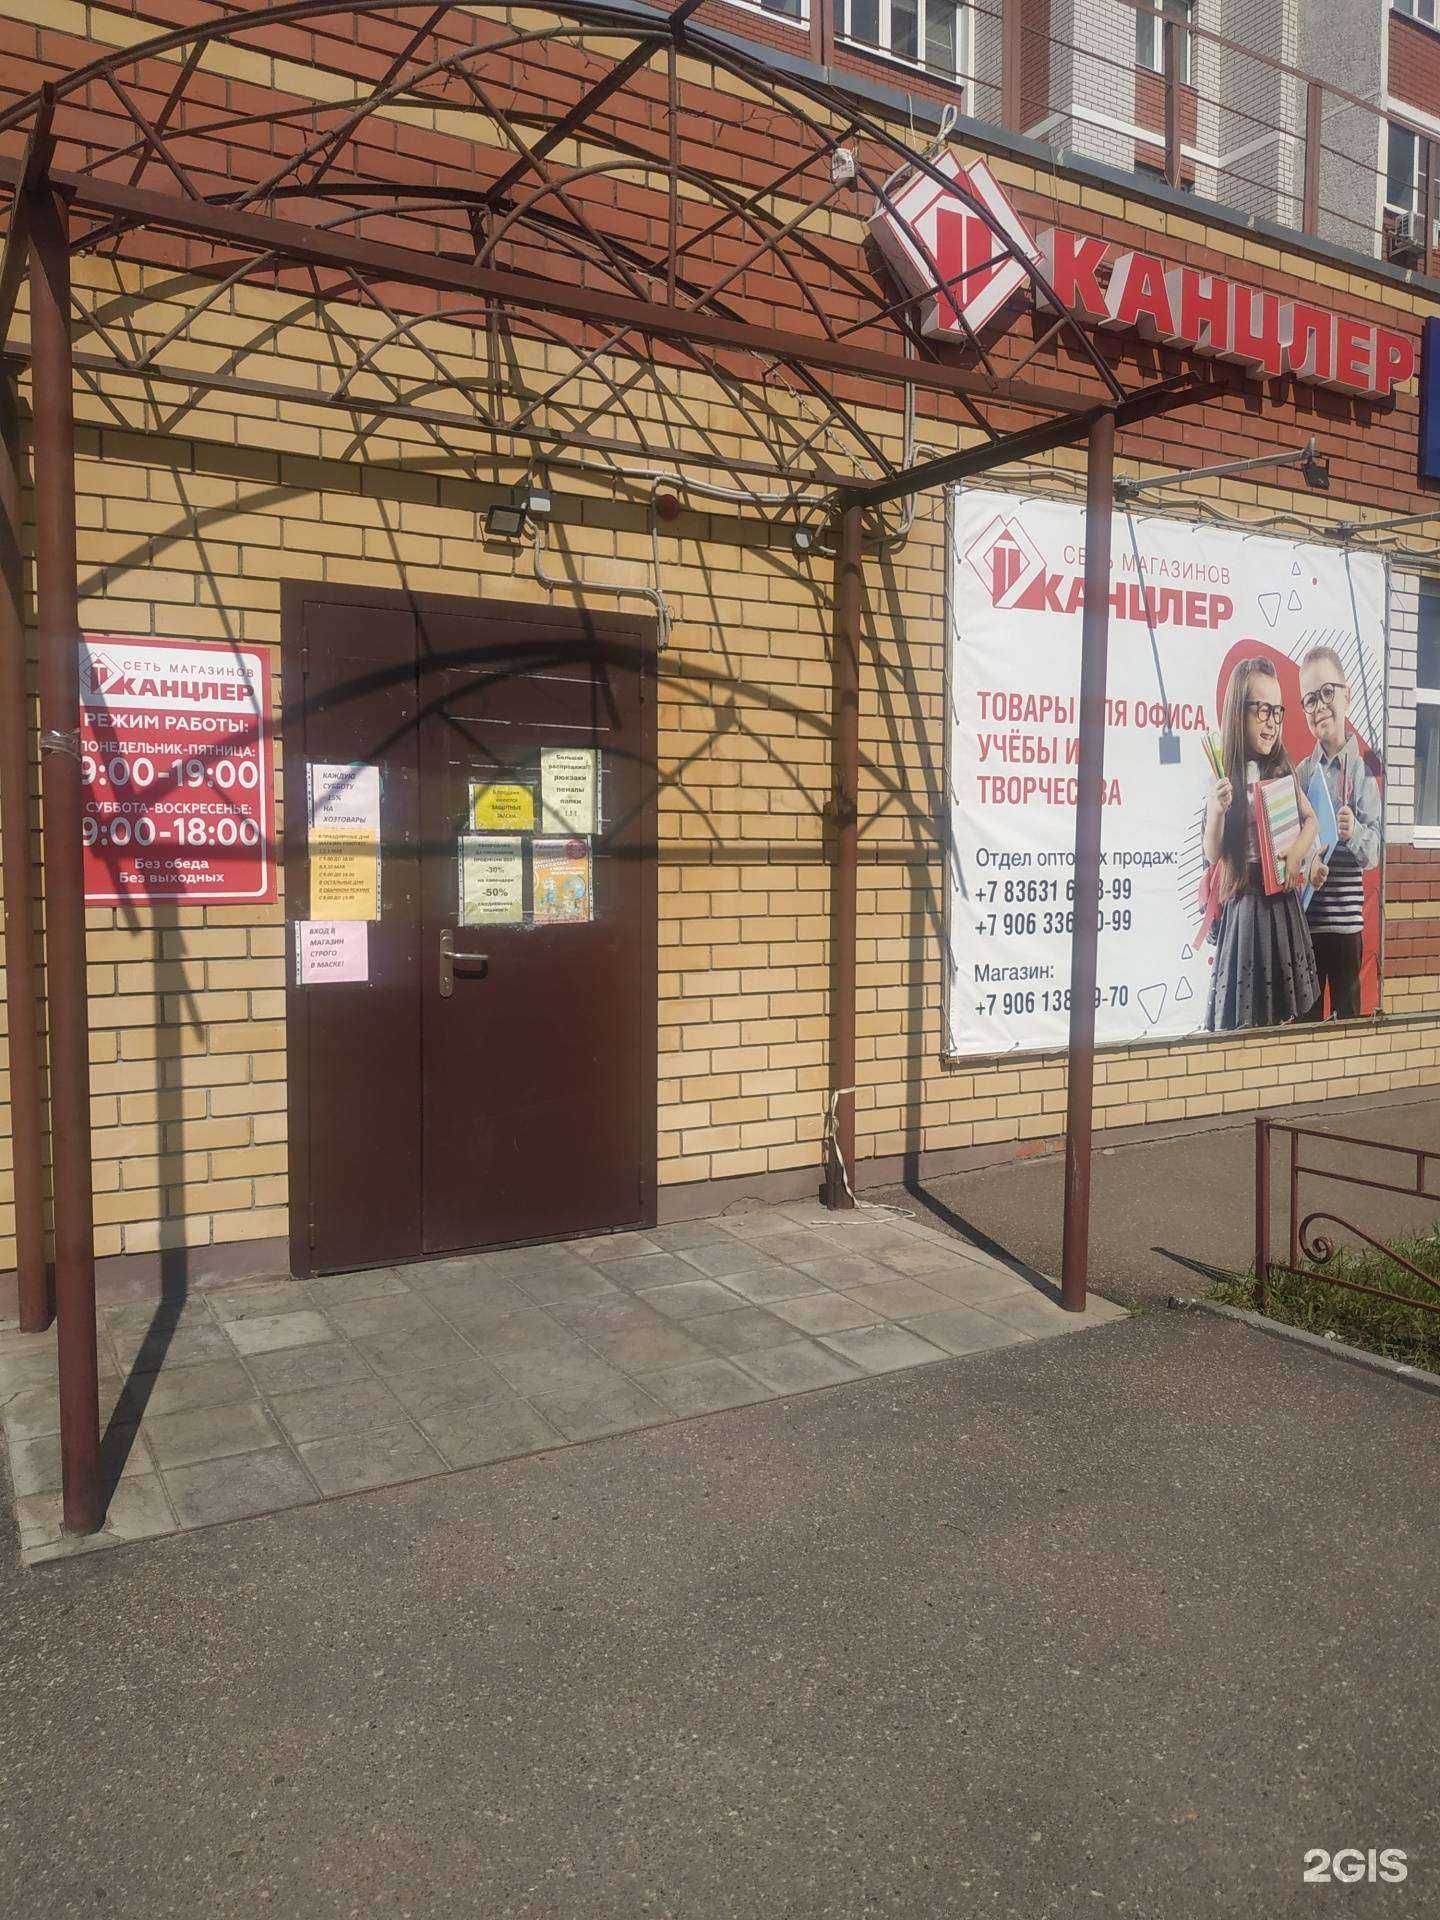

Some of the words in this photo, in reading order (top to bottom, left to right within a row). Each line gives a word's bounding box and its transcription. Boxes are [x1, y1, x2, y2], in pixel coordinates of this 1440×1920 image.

[1050, 228, 1416, 398] КАНЦЛЕР
[1063, 545, 1114, 570] СЕ
[1123, 553, 1231, 585] МАГАЗИНОВ
[123, 660, 161, 672] СЕТЬ
[169, 664, 255, 678] МАГАЗИНОВ
[119, 676, 255, 702] КАНЦЛЕР
[84, 713, 160, 730] РЕЖИМ
[165, 716, 249, 732] РАБОТЫ:
[977, 691, 1075, 724] ТОВАРЫ
[1104, 699, 1128, 727] ЛЯ
[1134, 700, 1211, 735] ОФИСА,
[977, 728, 1058, 764] УЧЁБЫ
[1065, 737, 1080, 765] И
[82, 756, 259, 788] 9:00-19:00
[323, 771, 356, 780] КАЖДУЮ
[977, 775, 1122, 806] ТВОРЧЕСВА
[86, 801, 253, 815] СУББОТА-ВОСКРЕСЕНЬЕ:
[82, 816, 260, 846] 9:00-18:00
[134, 858, 160, 870] Без
[164, 858, 209, 871] обеда
[976, 847, 1032, 870] Отдел
[1037, 851, 1108, 866] оптох
[1112, 850, 1178, 869] продаж:
[119, 872, 146, 884] Без
[149, 873, 225, 884] выходных
[482, 888, 508, 897] -50%
[975, 881, 998, 903] +7
[1004, 880, 1058, 903] 83631
[309, 927, 329, 935] ВХОД
[975, 913, 997, 936] +7
[1003, 912, 1036, 936] 906
[309, 938, 344, 946] МАГАЗИН
[974, 964, 1055, 983] Магазин:
[975, 994, 997, 1016] +7
[1003, 991, 1036, 1016] 906
